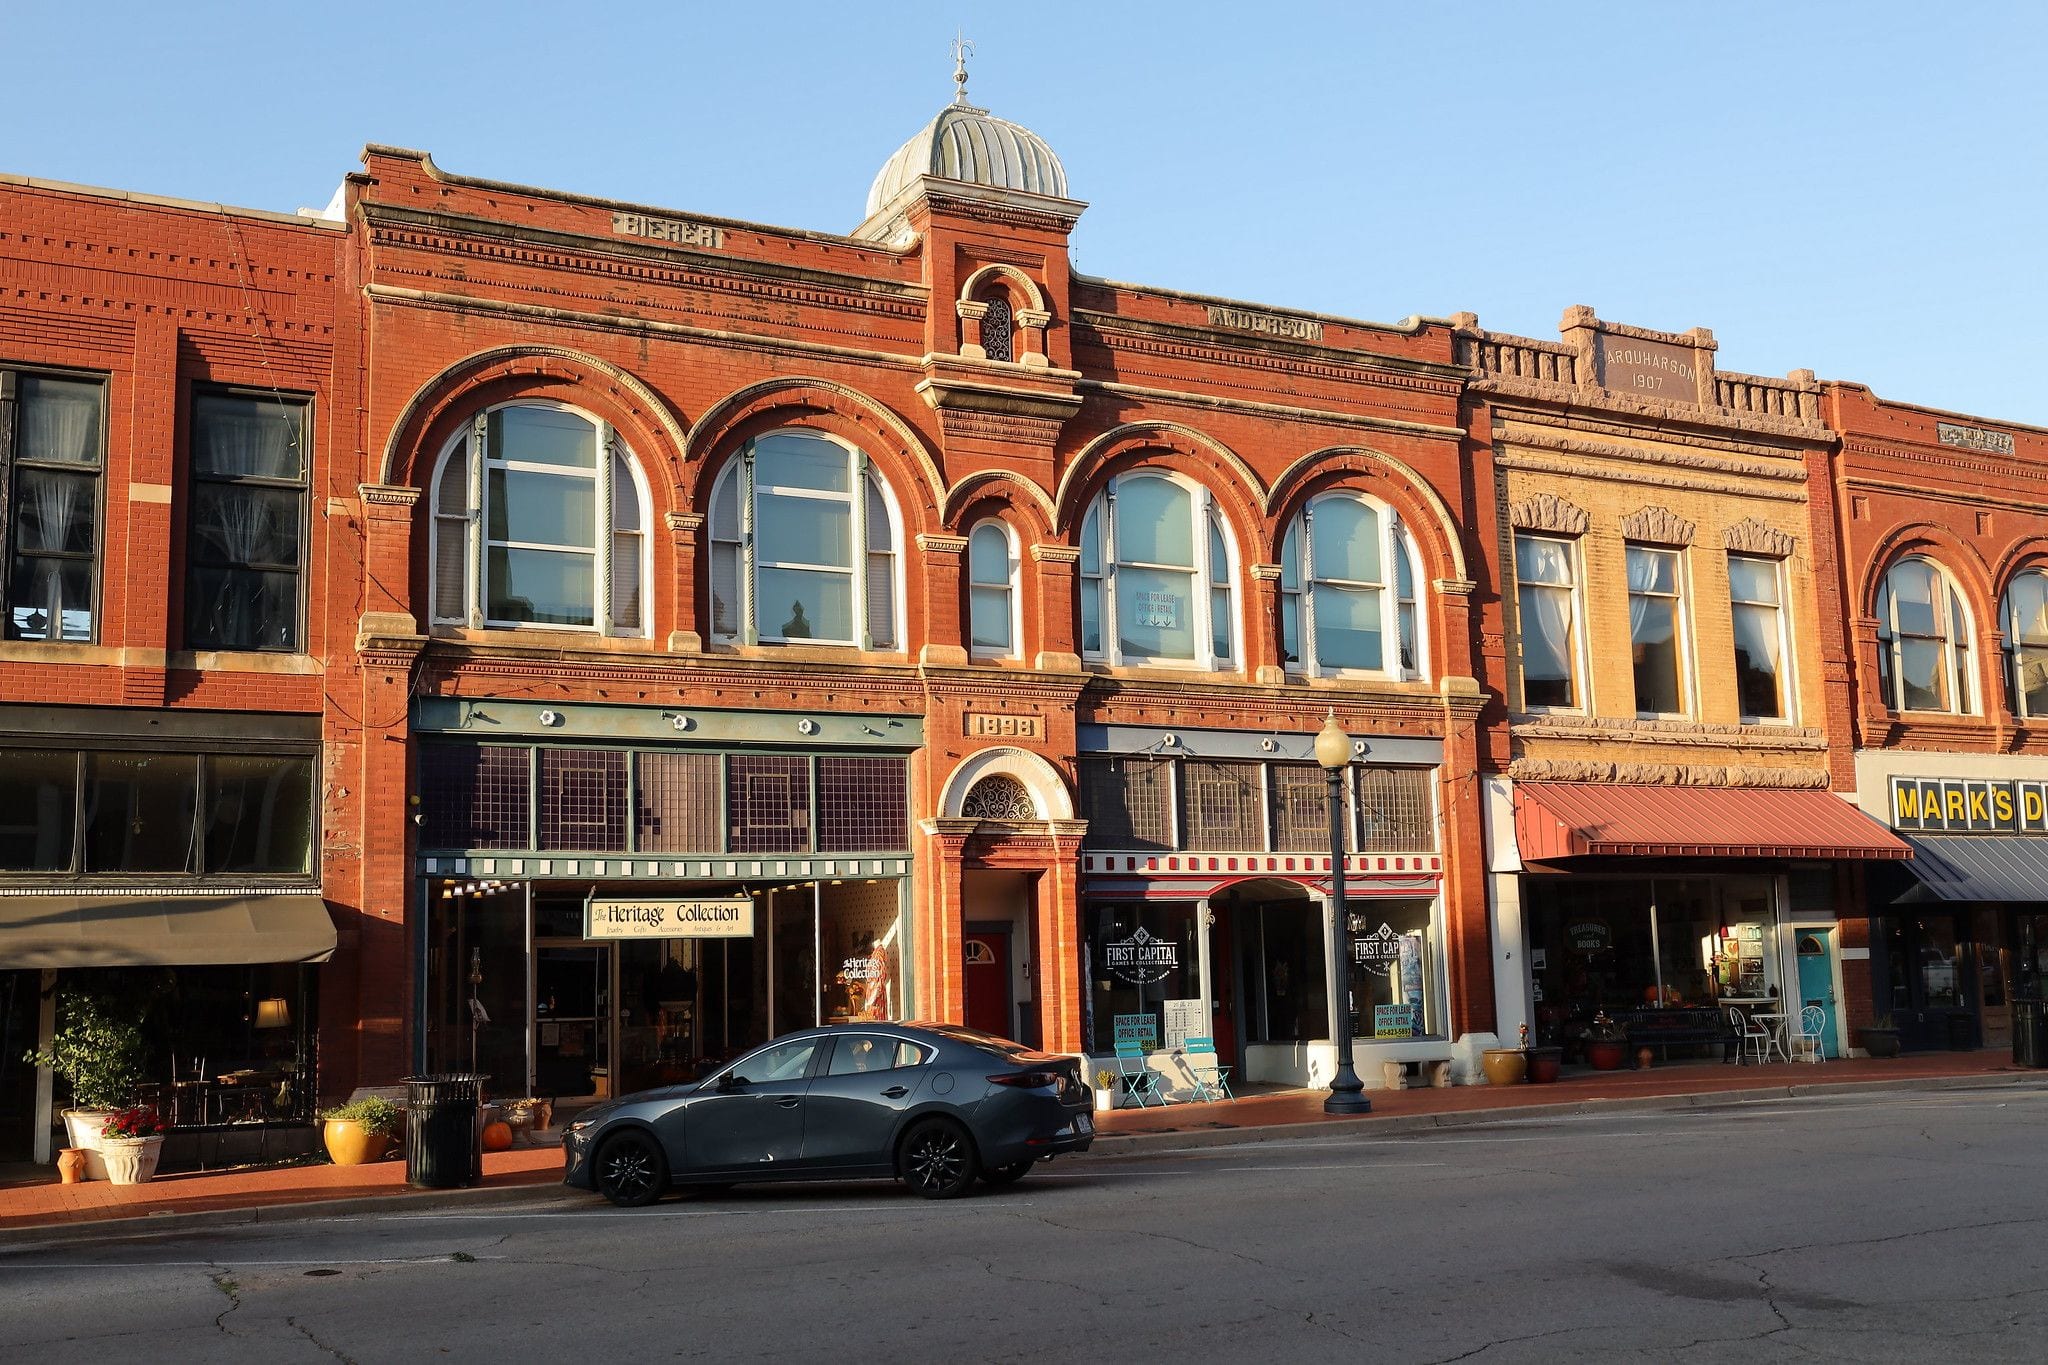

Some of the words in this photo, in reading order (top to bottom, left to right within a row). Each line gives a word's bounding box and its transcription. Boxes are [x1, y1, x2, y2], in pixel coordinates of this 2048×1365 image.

[624, 214, 714, 247] BIERER
[1210, 307, 1321, 341] ANDERSON
[1632, 373, 1663, 390] 1907
[976, 715, 1034, 736] 1898
[1897, 785, 2013, 822] MARK'S
[593, 909, 607, 922] The
[608, 905, 665, 927] Heritage
[677, 904, 739, 921] Collection
[1354, 942, 1380, 960] FIRST
[1577, 940, 1600, 949] BOOKS
[1106, 947, 1135, 966] FIRST
[1138, 946, 1178, 965] CAPITAL
[843, 968, 881, 979] Collection
[1376, 1006, 1390, 1016] SPACE
[1390, 1006, 1398, 1015] FOR
[1398, 1005, 1411, 1015] LEASE
[1115, 1016, 1130, 1026] SPACE
[1131, 1016, 1140, 1026] FOR
[1141, 1015, 1155, 1025] LEASE
[1378, 1017, 1393, 1026] OFFICE
[1118, 1028, 1135, 1038] OFFICE
[1137, 1028, 1154, 1037] RETAIL
